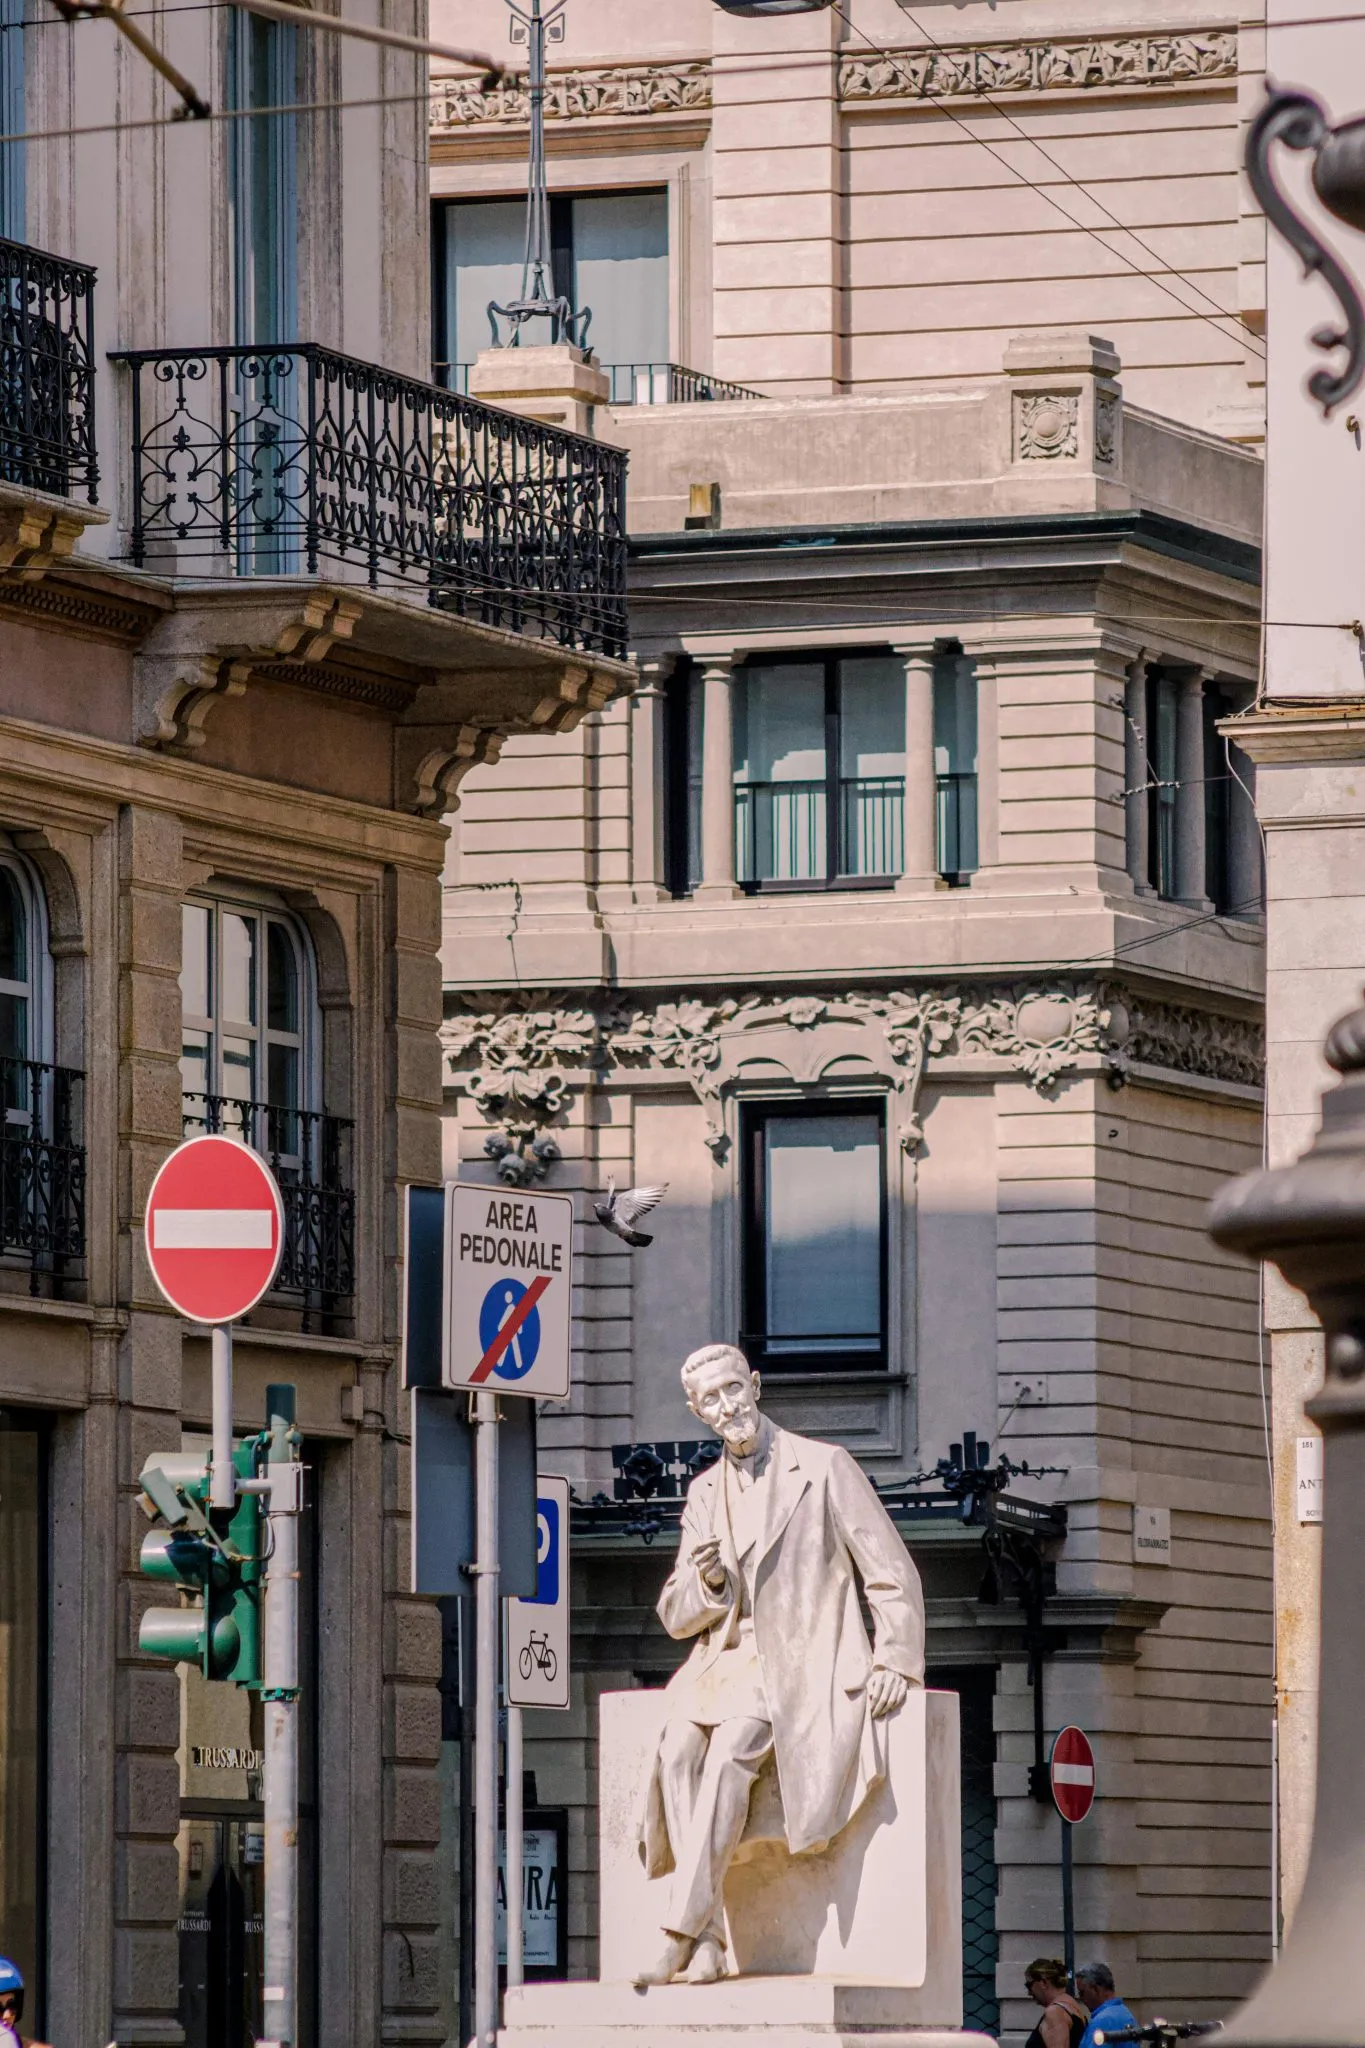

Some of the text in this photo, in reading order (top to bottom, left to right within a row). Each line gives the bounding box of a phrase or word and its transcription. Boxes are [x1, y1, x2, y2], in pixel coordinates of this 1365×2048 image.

[485, 1200, 538, 1233] AREA
[460, 1233, 563, 1272] PEDONALE
[197, 1746, 259, 1769] TRUSSARDI
